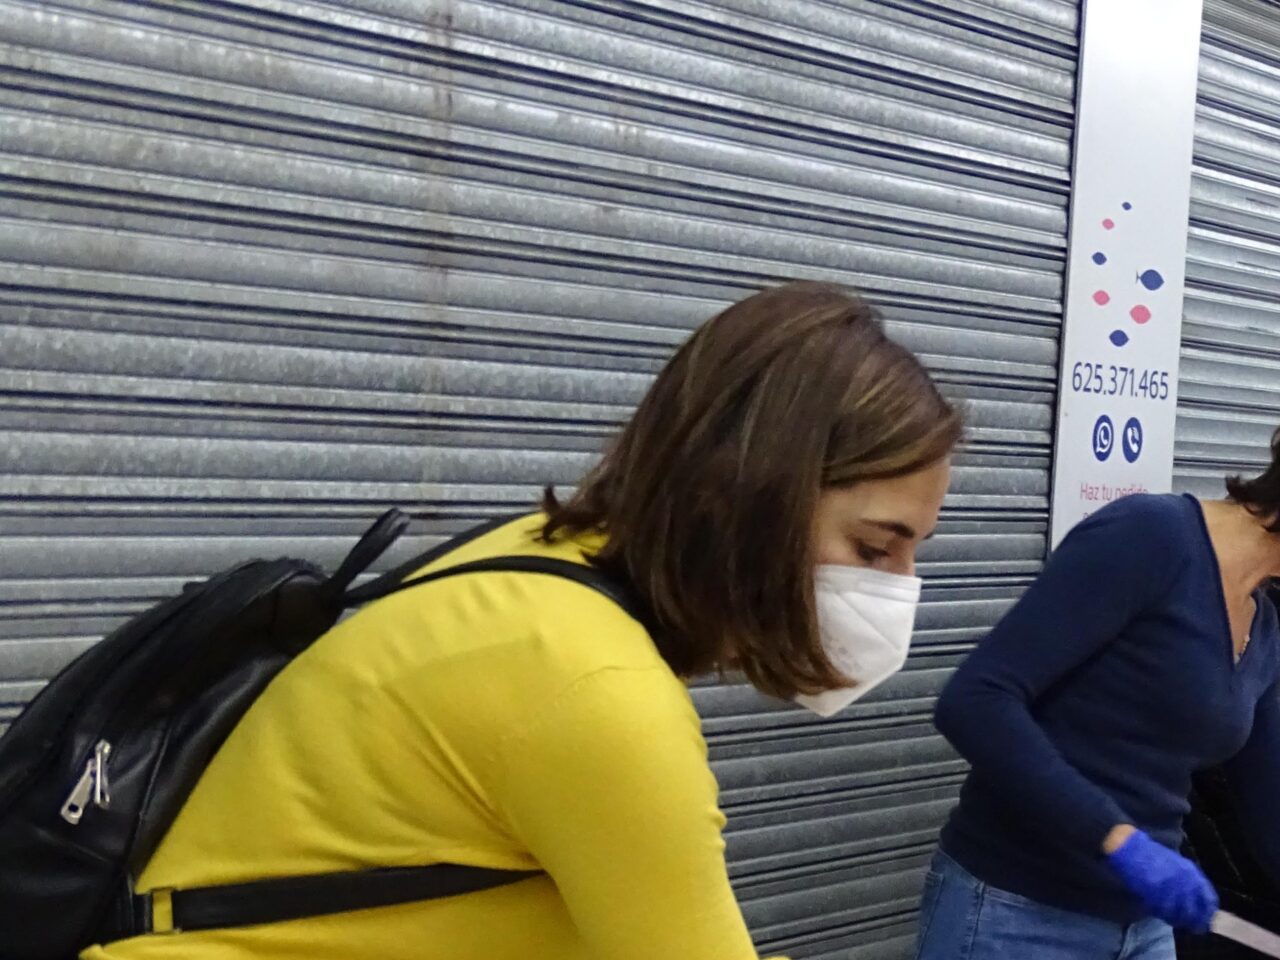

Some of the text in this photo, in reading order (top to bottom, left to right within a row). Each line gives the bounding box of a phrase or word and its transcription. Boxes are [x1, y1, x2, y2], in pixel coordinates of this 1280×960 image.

[1072, 361, 1169, 400] 625.371.465
[1080, 482, 1099, 501] Haz
[1102, 484, 1112, 501] tu
